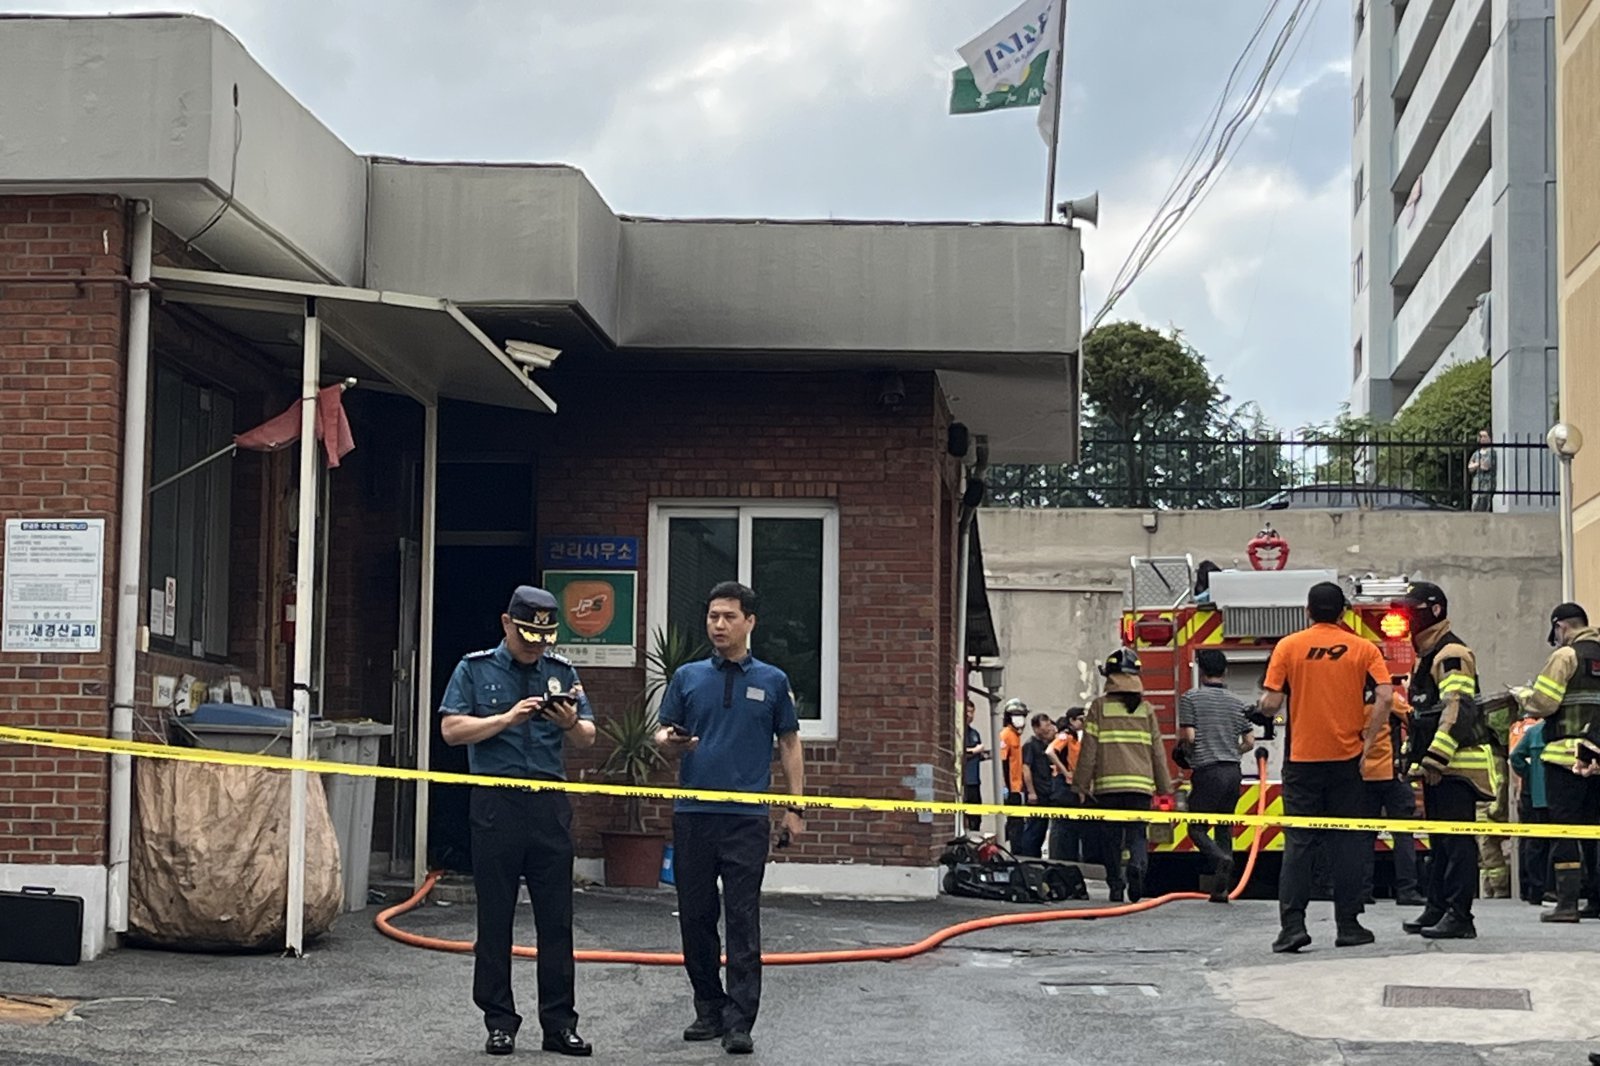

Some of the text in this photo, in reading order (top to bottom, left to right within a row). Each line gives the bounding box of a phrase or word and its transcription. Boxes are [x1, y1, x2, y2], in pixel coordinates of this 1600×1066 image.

[550, 543, 632, 561] 관리사무소
[571, 595, 604, 613] JPS
[31, 623, 96, 638] 새경산교회
[1306, 644, 1349, 661] 119
